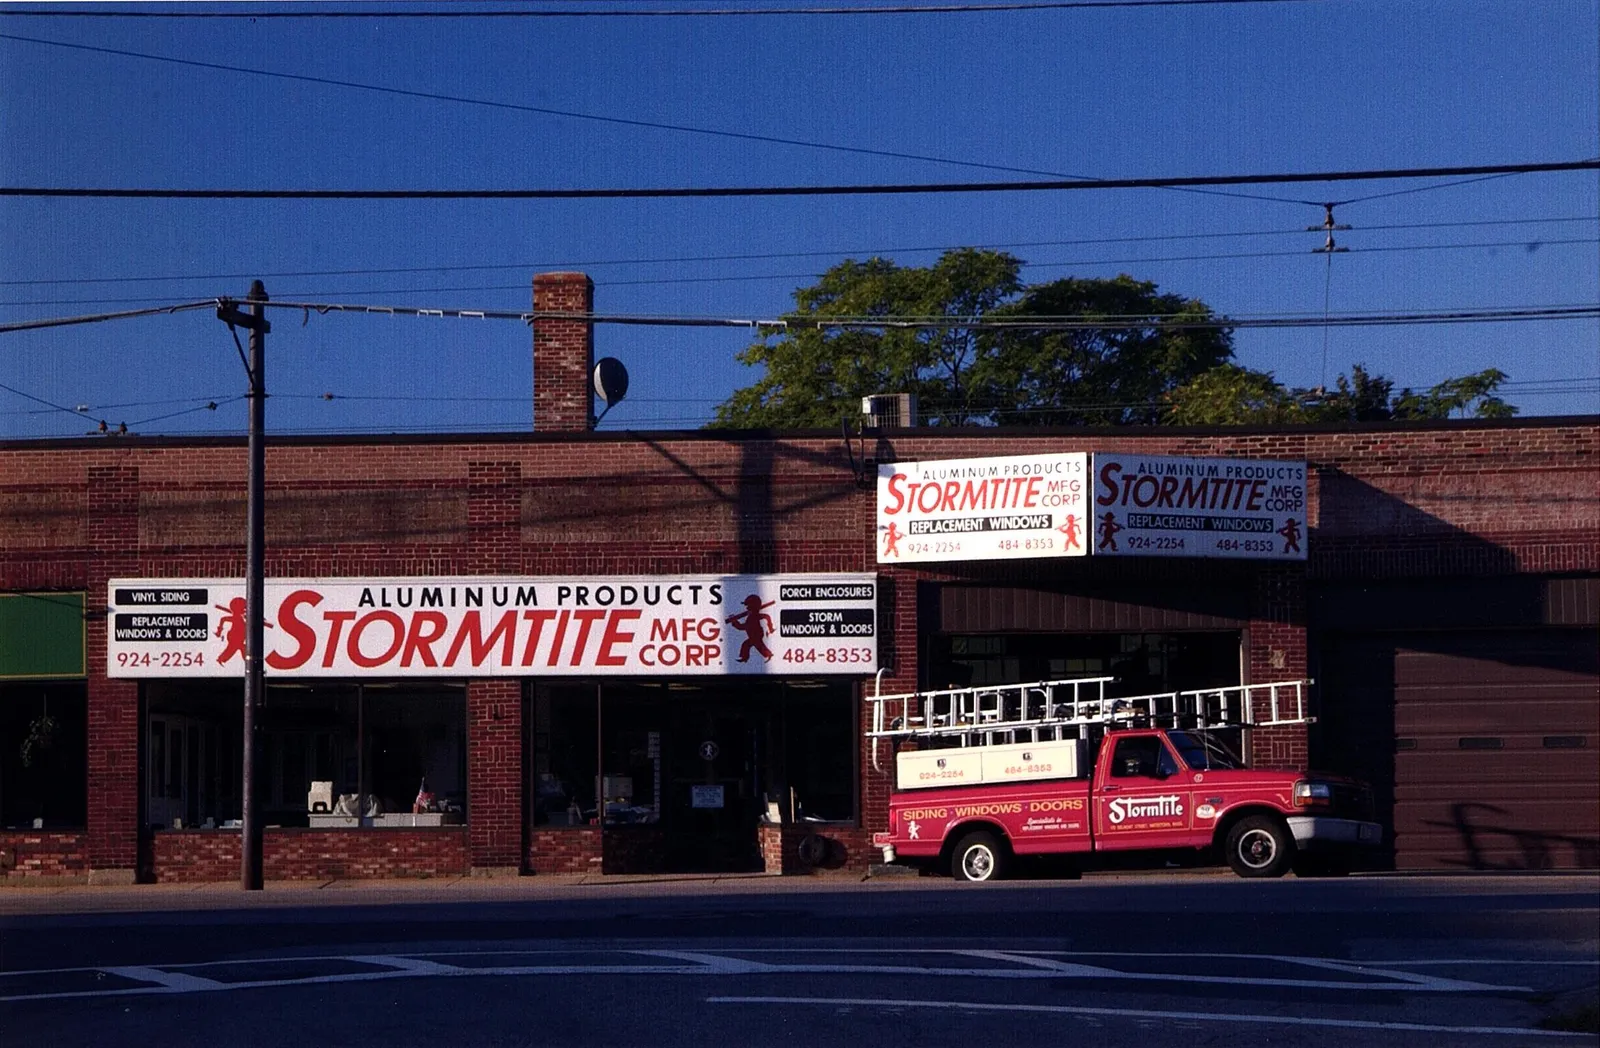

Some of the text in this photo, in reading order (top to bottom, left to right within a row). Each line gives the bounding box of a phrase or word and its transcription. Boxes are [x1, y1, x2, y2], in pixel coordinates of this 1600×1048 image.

[923, 461, 1082, 480] ALUMINUM PRODUCTS
[1138, 463, 1303, 480] ALUMINUM PRODUCTS
[884, 472, 1042, 516] STORMTITE
[1047, 480, 1081, 493] MFG
[1097, 462, 1269, 511] STORMTITE
[1271, 485, 1303, 499] MFG
[1041, 493, 1081, 507] CORP
[1265, 498, 1303, 513] CORP
[911, 514, 1050, 534] REPLACEMENT WINDOWS
[1128, 514, 1273, 533] REPLACEMENT WINDOWS
[908, 537, 1054, 553] 924-2254 484-8353
[1128, 536, 1274, 553] 924-2254 484-8353
[132, 592, 190, 602] VINYL SIDING
[358, 585, 723, 608] ALUMINUM PRODUCTS
[781, 586, 872, 597] PORCH ENCLOSURES
[132, 616, 191, 627] REPLACEMENT
[809, 611, 843, 623] STORM
[116, 629, 207, 639] WINDOWS & DOORS
[265, 589, 642, 670] STORMTITE
[650, 617, 723, 641] MFG.
[781, 624, 873, 635] WINDOWS & DOORS
[117, 651, 205, 667] 924-2254
[638, 644, 723, 667] CORP.
[782, 647, 872, 664] 484-8353
[919, 770, 964, 780] 924-2254
[1004, 764, 1052, 775] 484-8353
[903, 800, 1083, 821] SIDING WINDOWS DOORS
